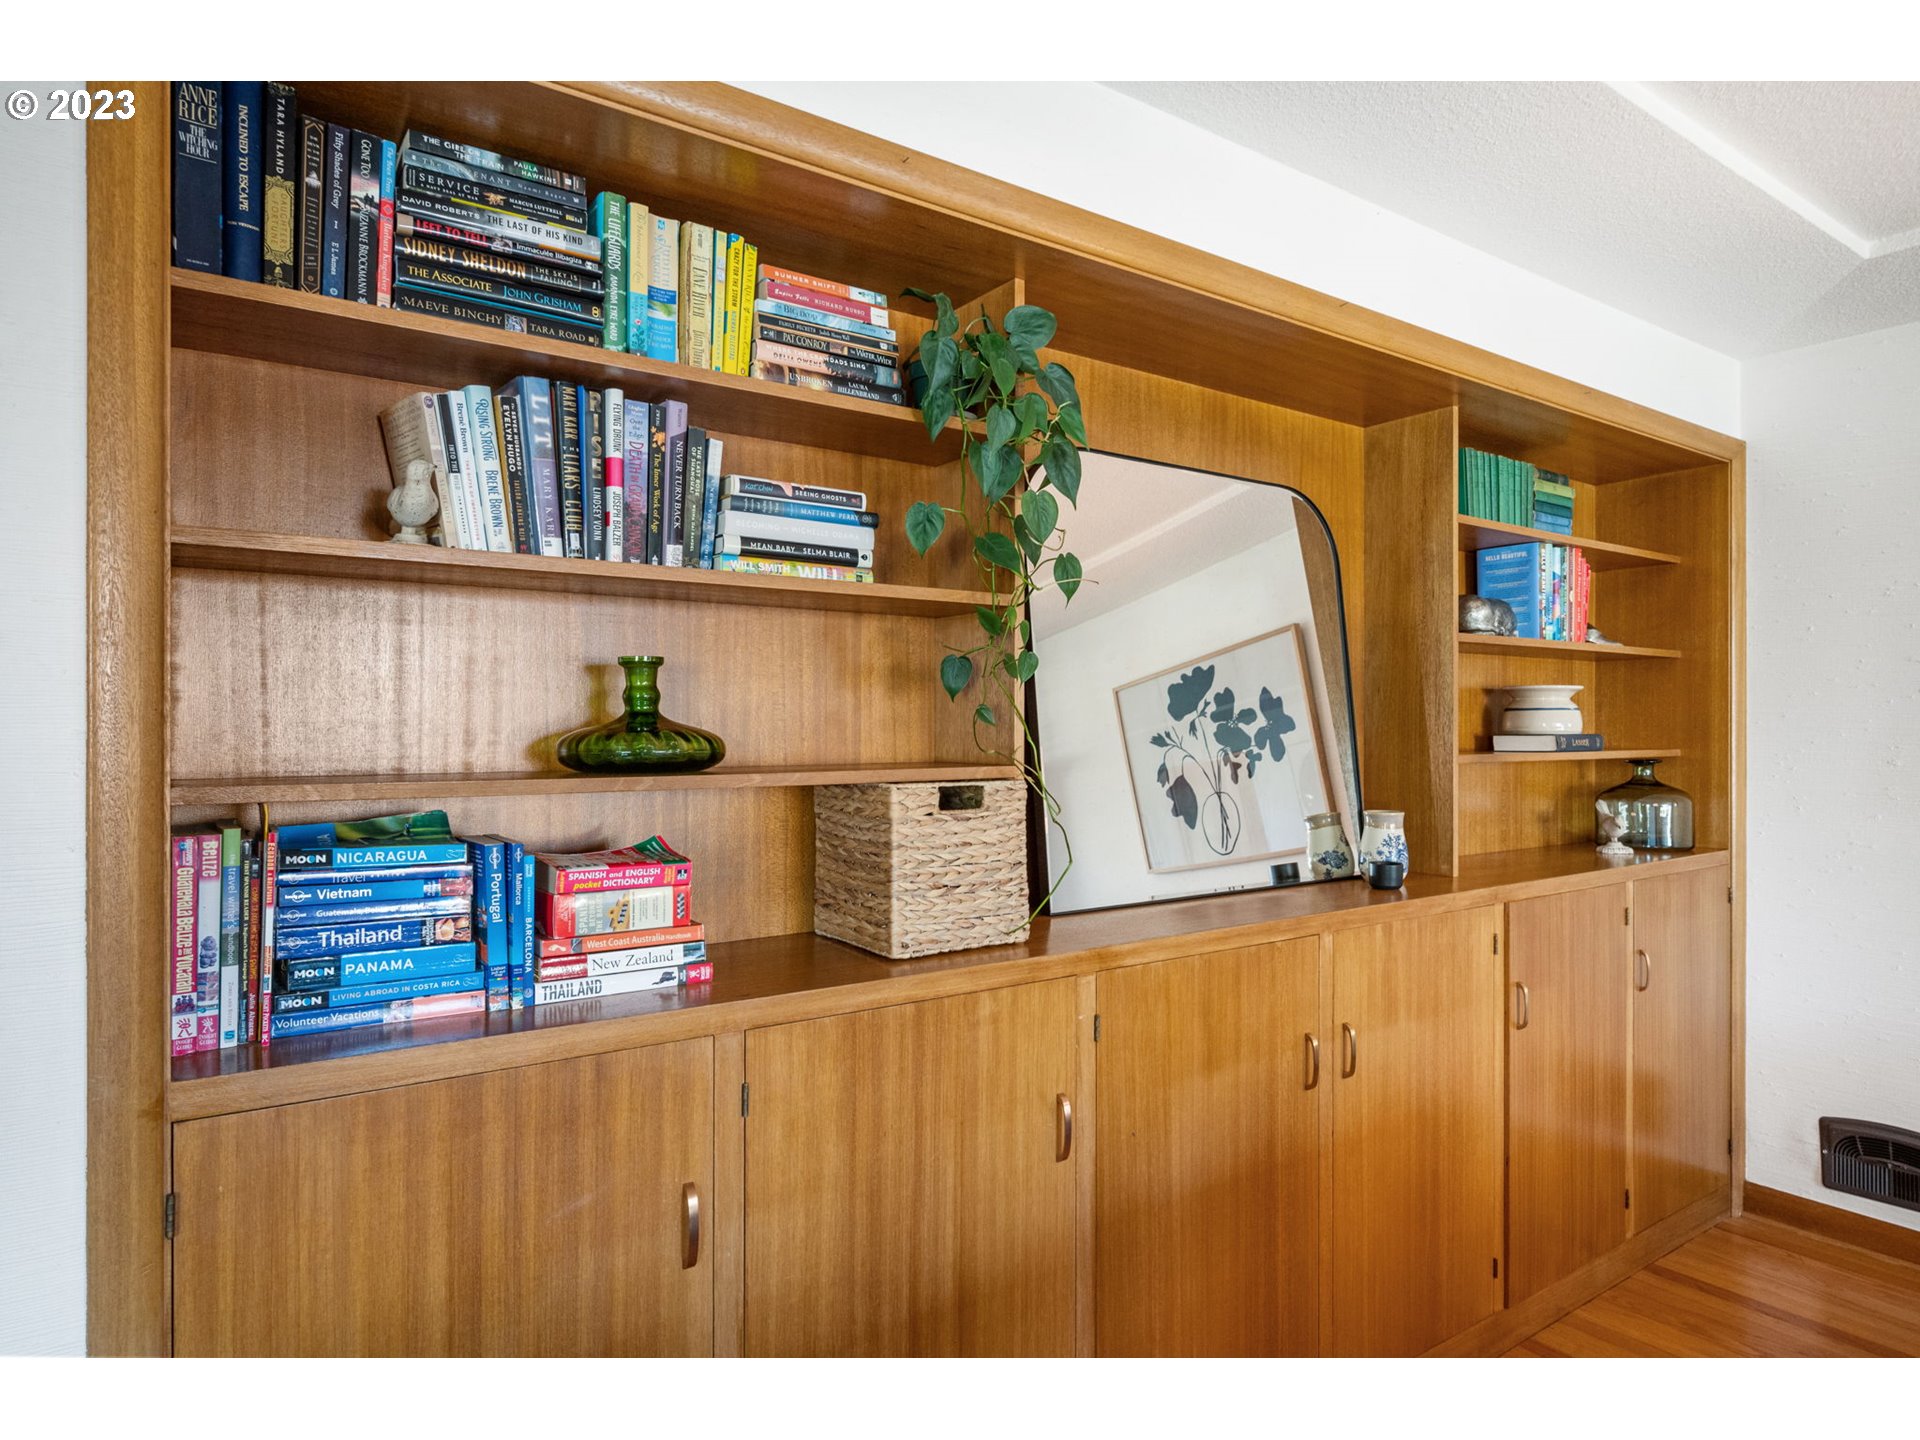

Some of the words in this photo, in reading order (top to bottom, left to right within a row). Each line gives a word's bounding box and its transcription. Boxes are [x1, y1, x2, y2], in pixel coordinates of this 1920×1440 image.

[179, 83, 217, 108] ANNE
[179, 100, 217, 126] RICE
[276, 98, 285, 126] TARA
[190, 125, 206, 136] THE
[239, 104, 248, 153] INCLINED
[179, 131, 218, 151] WITCHING
[186, 143, 210, 158] HOUR
[276, 130, 284, 174] HYLAND
[333, 132, 344, 150] Fifty
[361, 139, 372, 161] GONE
[423, 135, 440, 146] THE
[444, 141, 466, 153] GIRL
[468, 148, 481, 157] ON
[239, 157, 248, 171] TO
[333, 152, 343, 179] Shades
[360, 162, 370, 178] TOO
[455, 150, 473, 162] THE
[475, 155, 504, 170] TRAIN
[514, 160, 538, 173] PAULA
[333, 180, 342, 188] of
[419, 173, 480, 195] SERVICE
[522, 171, 557, 184] HAWKINS
[239, 174, 248, 211] ESCAPE
[331, 189, 341, 208] Grey
[402, 195, 432, 207] DAVID
[435, 203, 480, 219] ROBERTS
[610, 202, 620, 215] THE
[359, 208, 370, 243] SUZANNE
[416, 219, 442, 233] LEFT
[444, 225, 461, 240] TO
[463, 231, 487, 247] TELL
[487, 215, 504, 225] THE
[507, 219, 529, 233] LAST
[531, 225, 542, 235] OF
[546, 229, 560, 240] HIS
[563, 233, 583, 246] KIND
[608, 218, 621, 271] LIFEGUARDS
[358, 244, 369, 295] BROCKMANN
[404, 239, 455, 263] SIDNEY
[463, 250, 526, 278] SHELDON
[407, 266, 429, 278] THE
[432, 271, 492, 292] ASSOCIATE
[610, 274, 618, 303] AMANDA
[693, 267, 706, 288] CANE
[774, 271, 810, 284] SUMMER
[813, 280, 837, 290] SHIFT
[503, 285, 532, 300] JOHN
[534, 292, 582, 312] GRISHAM
[692, 291, 707, 317] RIVER
[404, 297, 449, 314] MAEVE
[454, 307, 503, 324] BINCHY
[610, 305, 618, 321] EYRE
[530, 323, 555, 335] TARA
[559, 329, 585, 341] ROAD
[609, 322, 617, 340] WARD
[783, 333, 795, 343] PAT
[796, 336, 828, 349] CONROY
[790, 373, 833, 388] UNBROKEN
[849, 382, 868, 391] LAURA
[563, 386, 576, 413] MARY
[837, 387, 879, 400] HILLENBRAND
[457, 403, 466, 426] Brené
[476, 399, 490, 429] RISING
[503, 405, 513, 443] EVELYN
[532, 394, 552, 448] LIT
[613, 403, 622, 427] FLYING
[565, 416, 578, 439] KARR
[589, 391, 601, 479] RISE
[460, 428, 468, 453] Brown
[480, 431, 496, 461] STRONG
[613, 429, 621, 452] DRUNK
[448, 444, 456, 460] INTO
[506, 444, 515, 472] HUGO
[630, 441, 643, 473] DEATH
[675, 440, 683, 472] NEVER
[485, 470, 501, 496] BRENÉ
[674, 475, 682, 501] TURN
[593, 487, 602, 518] LINDSEY
[795, 490, 819, 498] SEEING
[821, 493, 847, 502] GHOSTS
[490, 499, 503, 528] BROWN
[566, 500, 582, 531] CLUB
[801, 509, 836, 517] MATTHEW
[838, 513, 859, 521] PERRY
[593, 519, 602, 541] VONN
[613, 520, 621, 546] BALZER
[650, 519, 659, 533] Age
[750, 543, 773, 551] MEAN
[803, 548, 827, 556] SELMA
[830, 550, 851, 559] BLAIR
[731, 560, 755, 570] WILL
[759, 562, 790, 574] SMITH
[286, 855, 326, 864] MOON
[336, 850, 427, 863] NICARAGUA
[228, 868, 236, 893] travel
[568, 871, 606, 880] SPANISH
[625, 868, 661, 877] ENGLISH
[573, 881, 601, 891] pocket
[603, 877, 654, 888] DICTIONARY
[317, 888, 372, 899] Vietnam
[489, 873, 502, 923] Portugal
[227, 896, 236, 928] writer's
[318, 926, 402, 947] Thailand
[587, 940, 607, 949] West
[608, 938, 630, 946] Coast
[631, 934, 665, 945] Australia
[344, 958, 414, 975] PANAMA
[592, 959, 620, 970] New
[625, 950, 673, 966] Zealand
[294, 968, 335, 978] MOON
[332, 993, 361, 1001] LIVING
[365, 988, 399, 996] ABROAD
[413, 982, 440, 991] COSTA
[542, 980, 602, 1001] THAILAND
[281, 997, 322, 1008] MOON
[276, 1016, 328, 1029] Volunteer
[330, 1010, 379, 1022] Vacations
